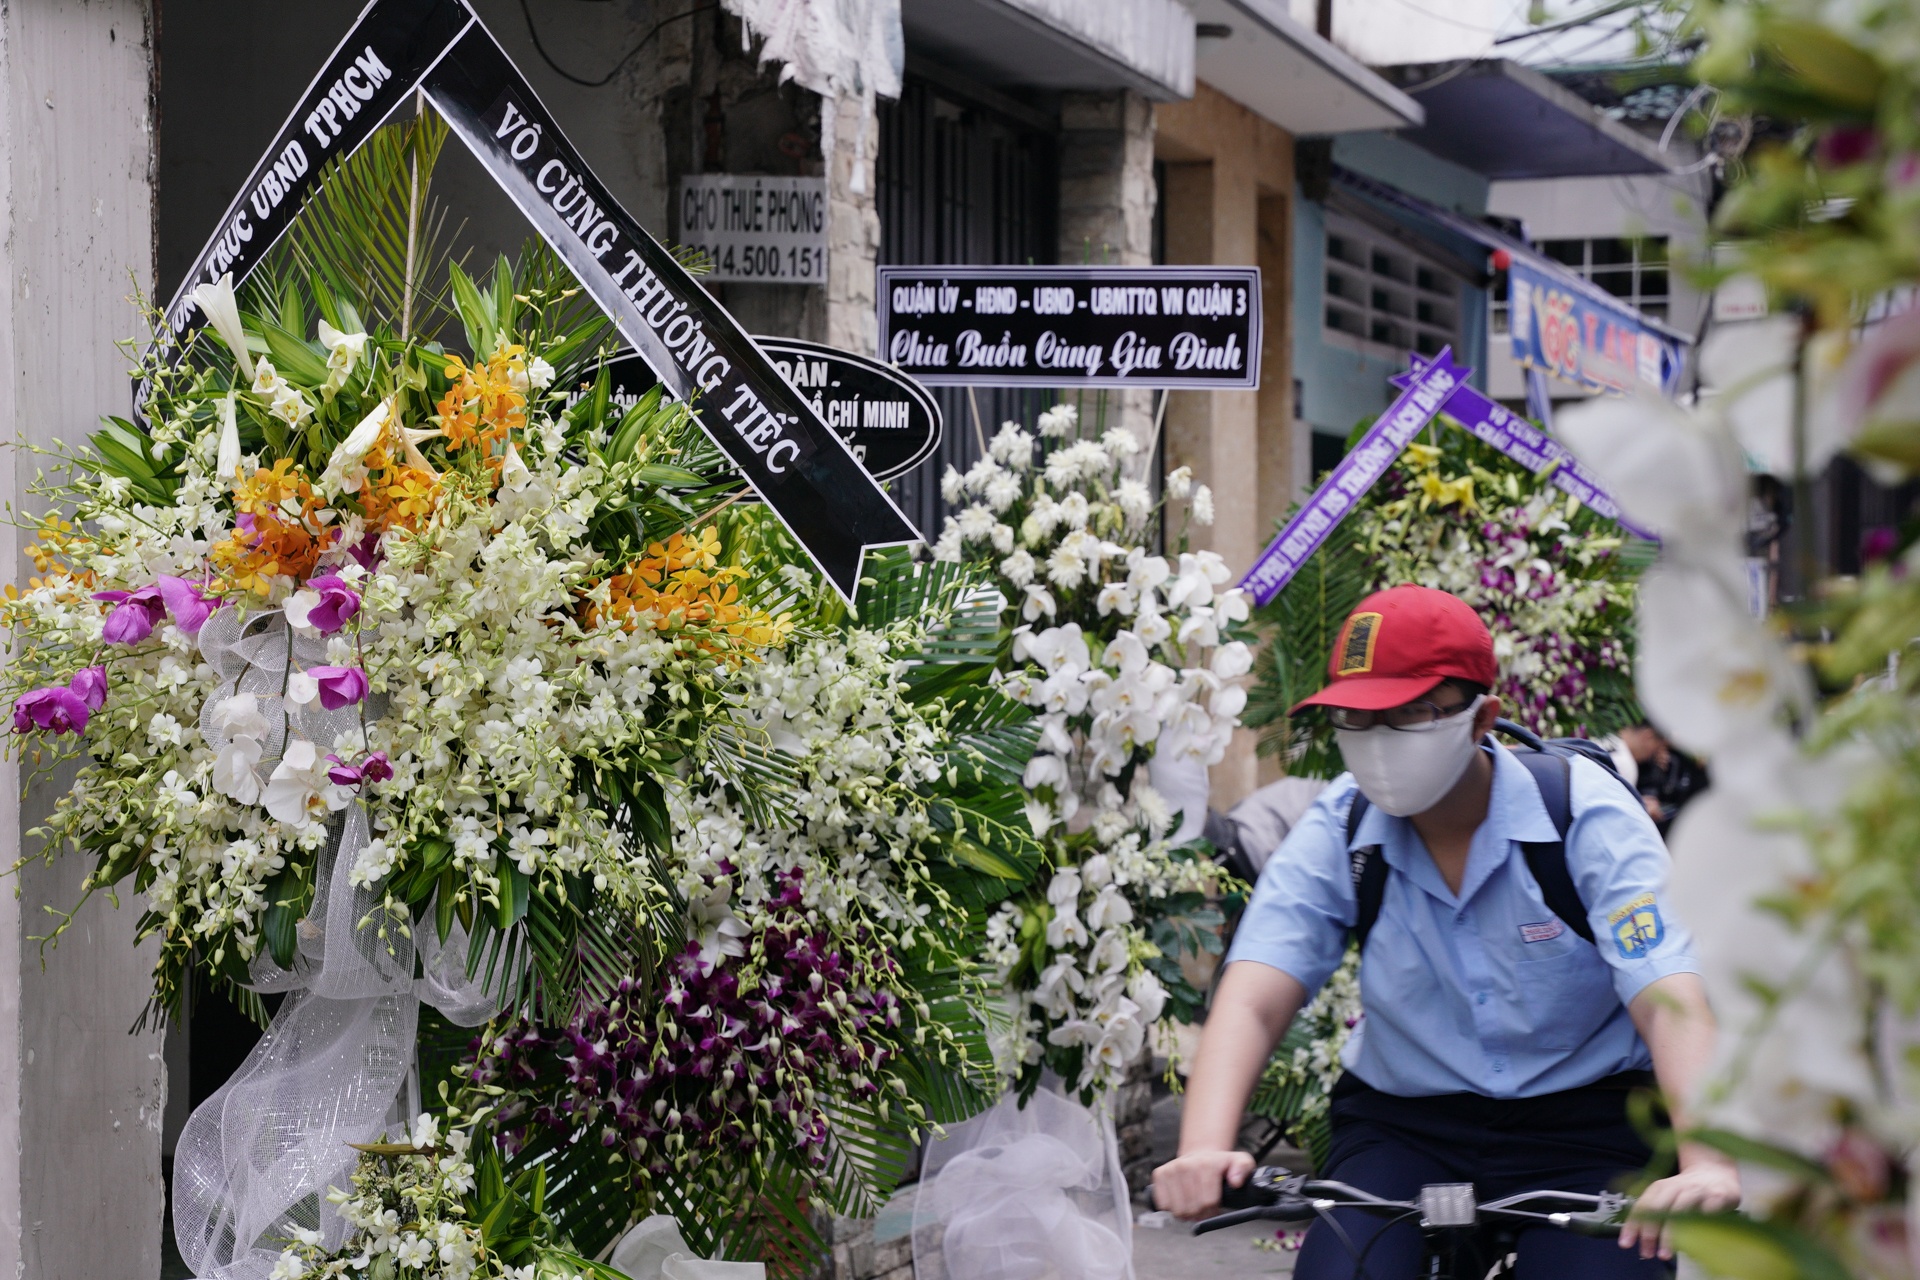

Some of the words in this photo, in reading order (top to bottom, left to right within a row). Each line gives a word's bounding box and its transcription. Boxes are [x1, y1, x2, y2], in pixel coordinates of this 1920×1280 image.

[205, 210, 254, 285] TRỰC
[250, 139, 310, 221] UBND
[303, 45, 393, 149] TPHCM
[683, 187, 718, 231] CHO
[722, 179, 764, 232] THUÊ
[766, 180, 824, 234] PHÒNG
[494, 101, 544, 161] VÔ
[536, 158, 620, 260] CÙNG
[611, 248, 732, 395] THƯƠNG
[720, 384, 801, 475] TIẾC
[892, 281, 936, 319] QUẬN
[938, 278, 960, 314] ỦY
[975, 286, 1018, 315] HĐND
[1033, 286, 1075, 315] UBND
[1090, 286, 1158, 316] UBMTTQ
[1160, 286, 1184, 316] VN
[1186, 281, 1233, 321] QUẬN
[1235, 287, 1247, 317] 3
[775, 355, 829, 388] OÀN
[889, 328, 950, 368] Chia
[955, 328, 1029, 368] Buồn
[1034, 330, 1104, 377] Cùng
[1108, 330, 1163, 378] Gia
[1168, 331, 1243, 371] Đình
[828, 393, 860, 428] CHÍ
[863, 400, 910, 429] MINH
